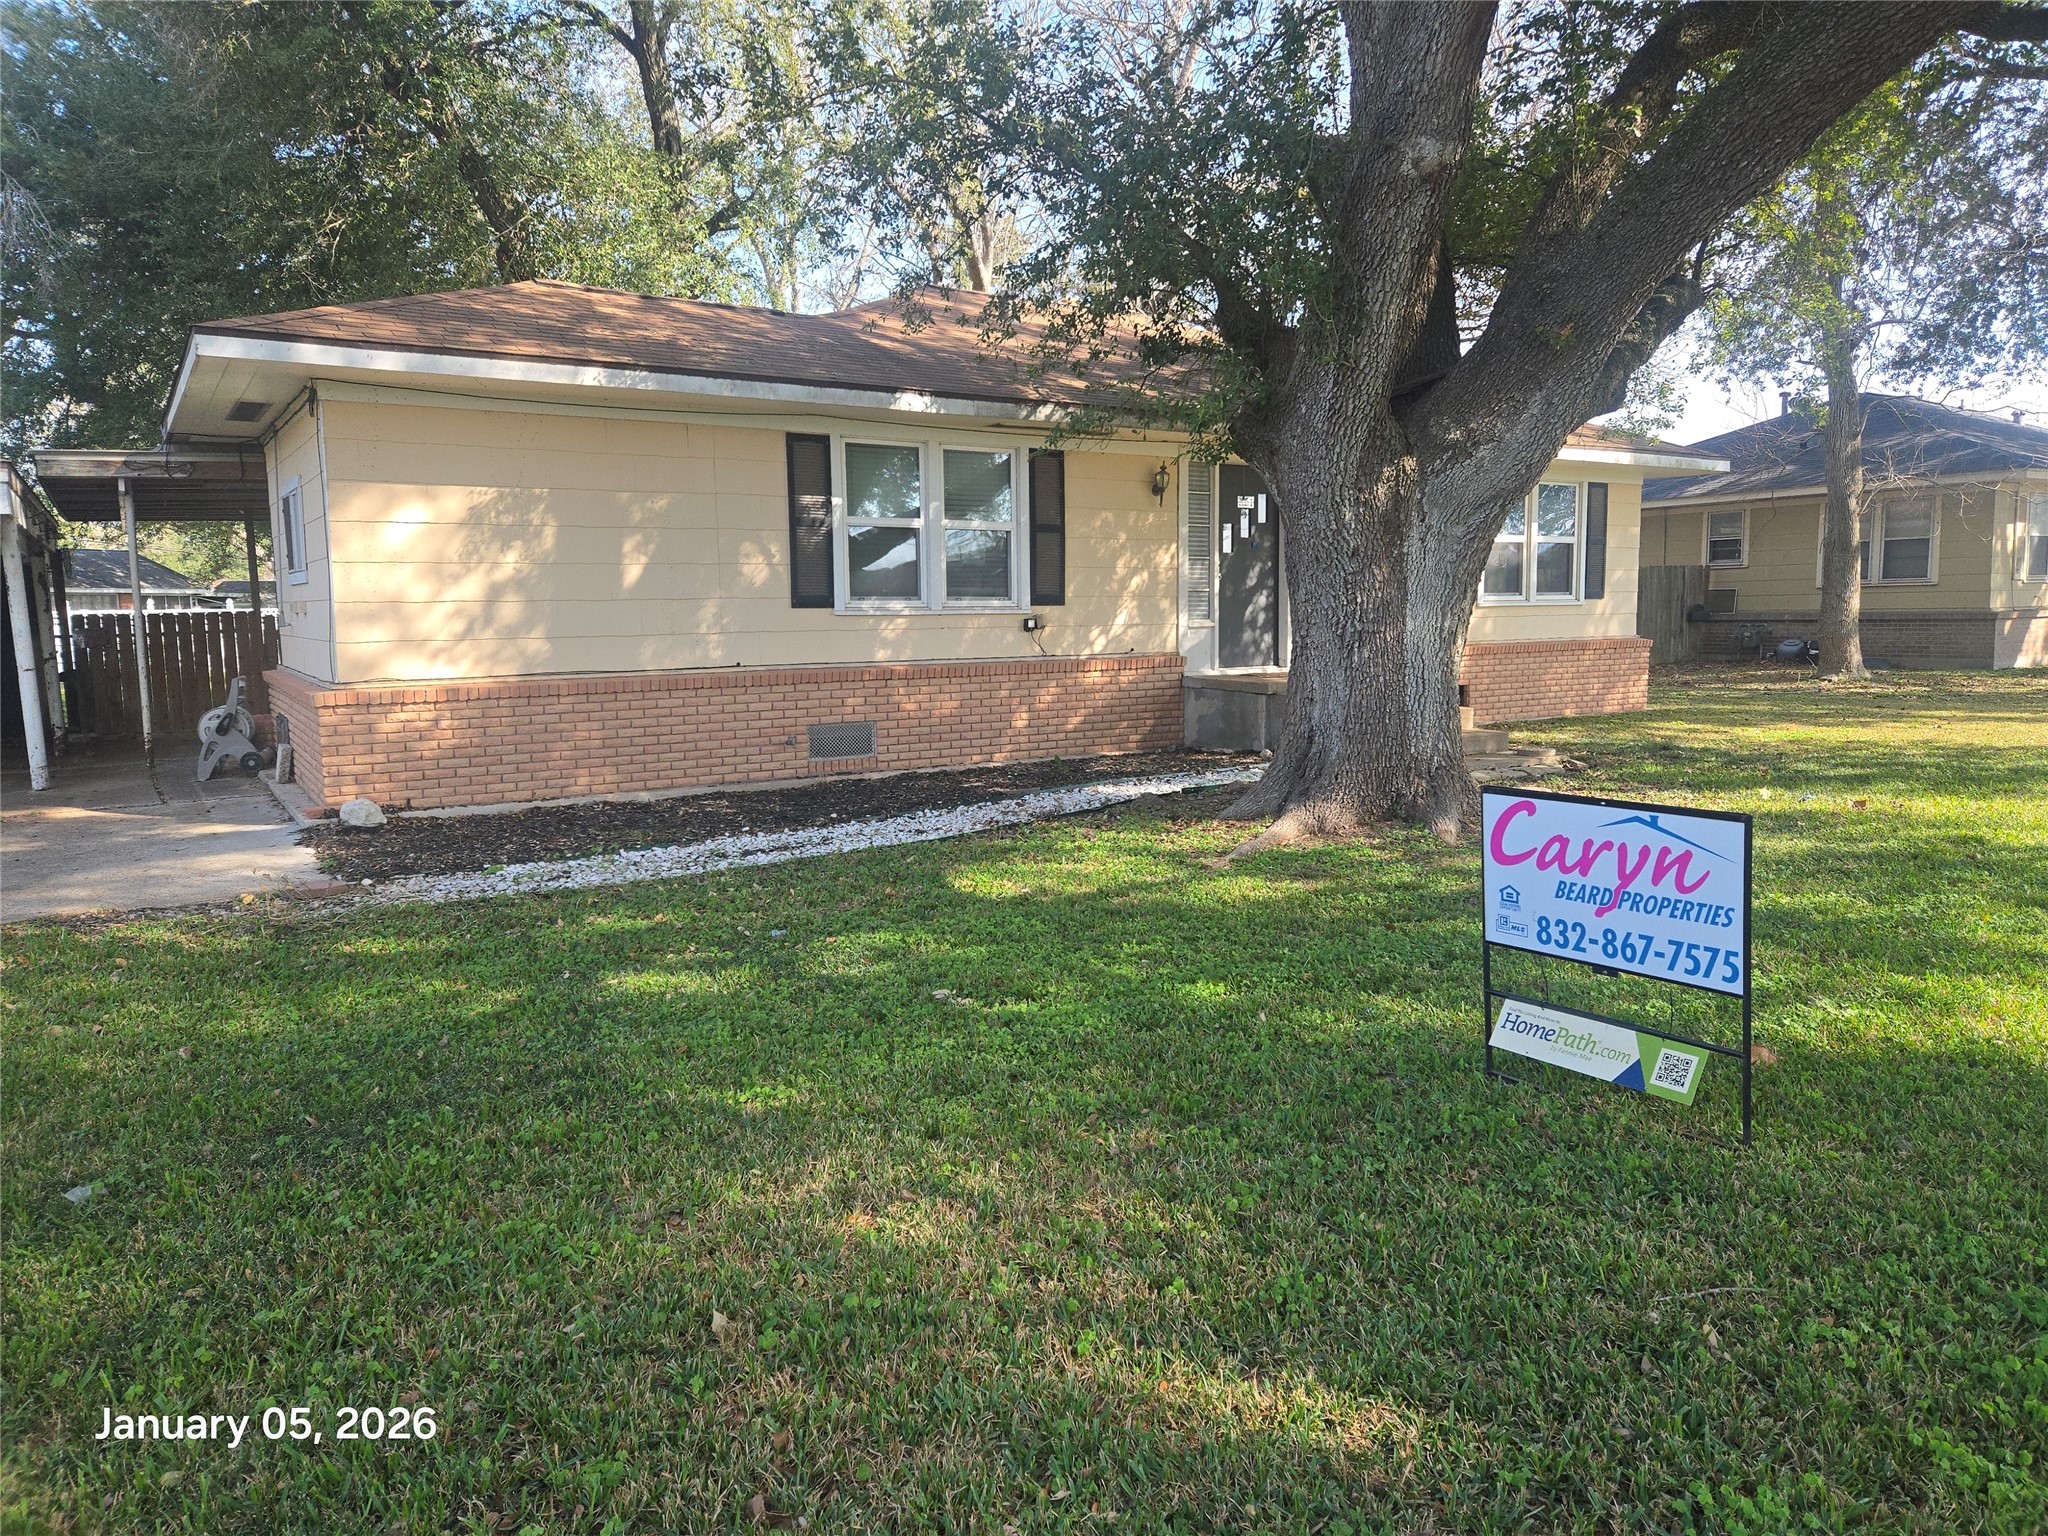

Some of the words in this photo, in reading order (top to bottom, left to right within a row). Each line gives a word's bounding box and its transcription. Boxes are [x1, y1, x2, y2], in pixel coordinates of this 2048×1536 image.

[1490, 800, 1711, 917] Caryn
[1554, 880, 1613, 906] BEARD
[1617, 891, 1735, 928] PROPERTIES
[1536, 915, 1740, 984] 832-867-7575
